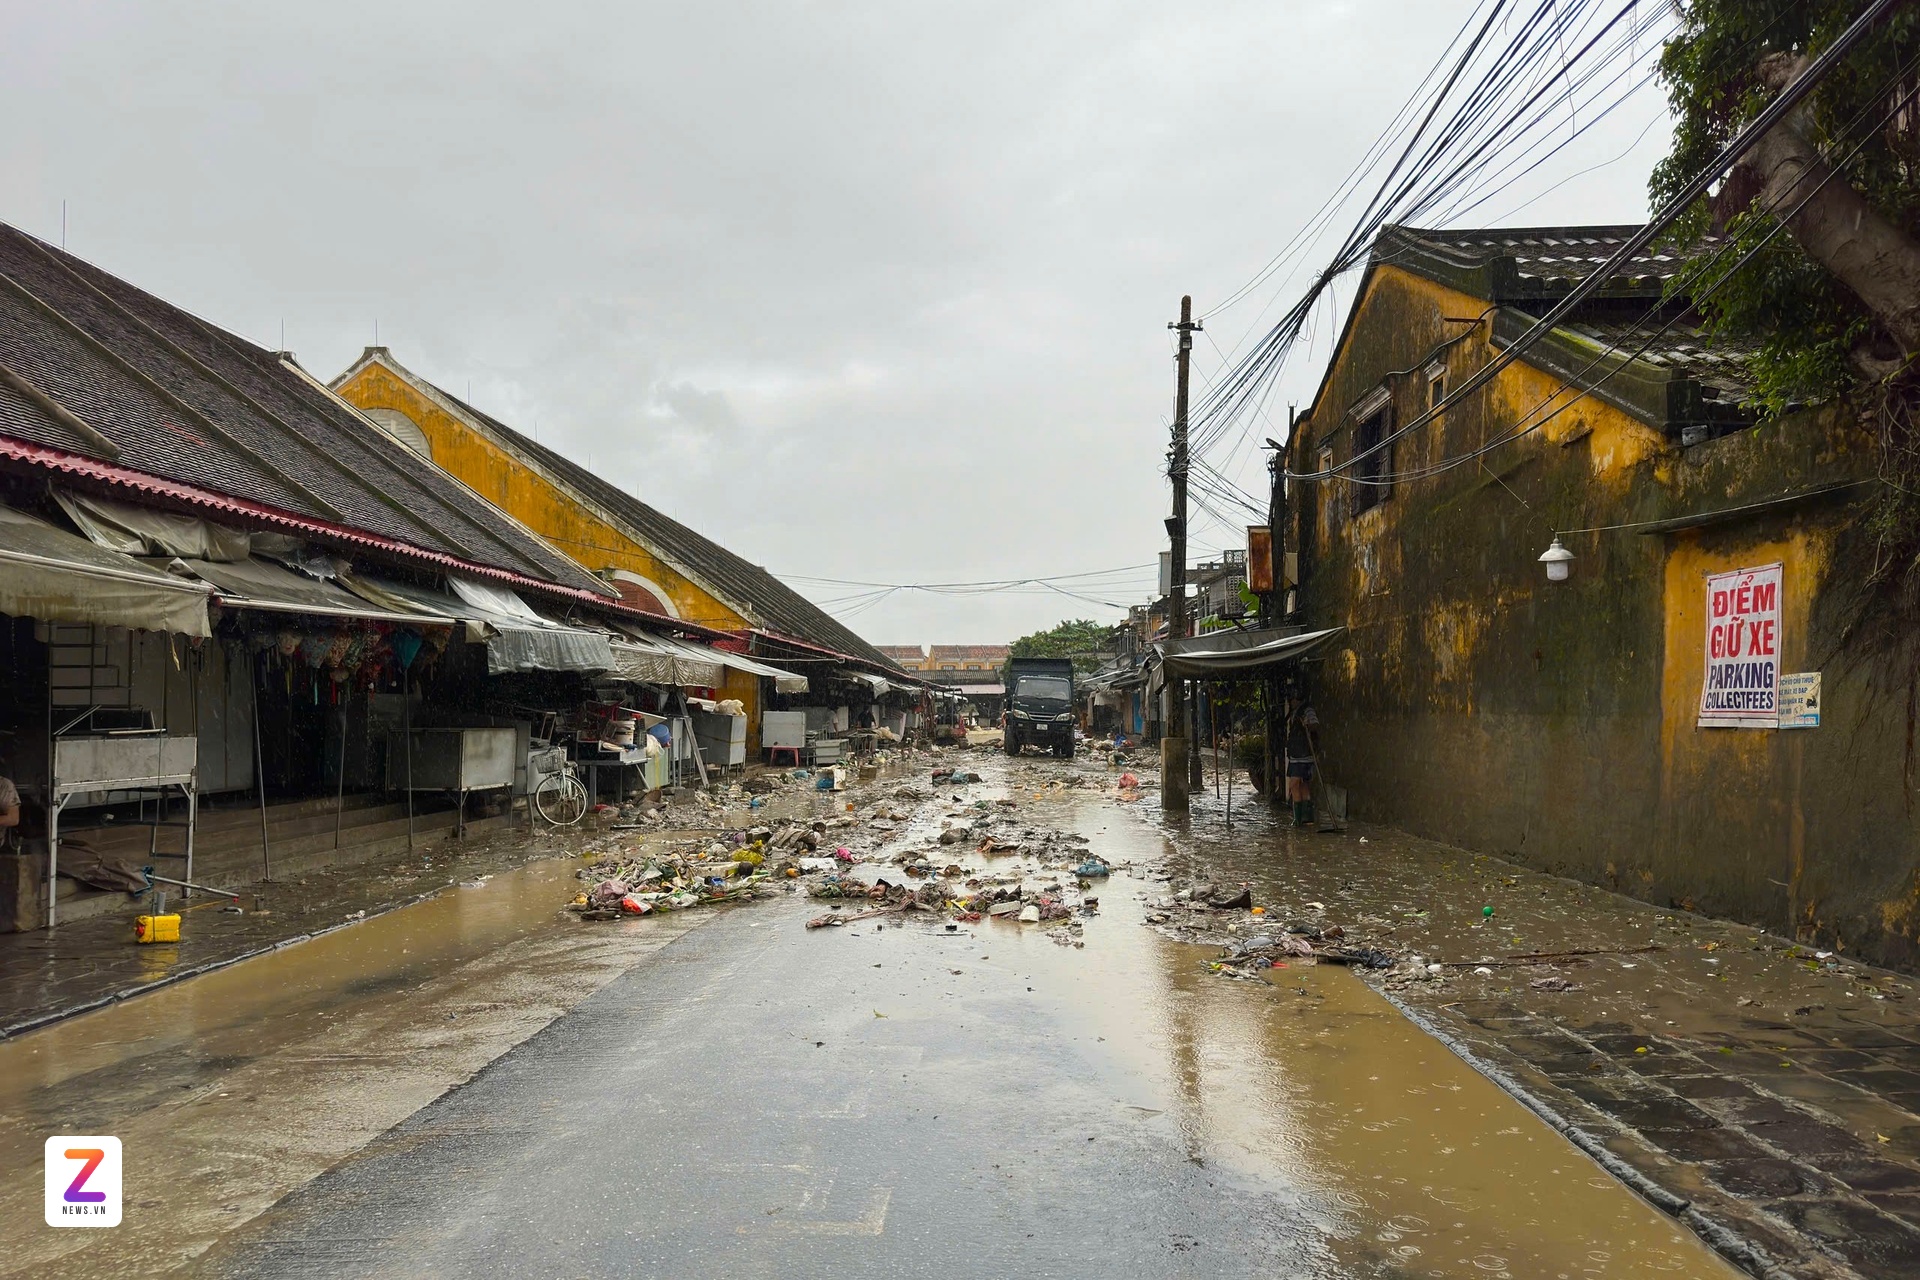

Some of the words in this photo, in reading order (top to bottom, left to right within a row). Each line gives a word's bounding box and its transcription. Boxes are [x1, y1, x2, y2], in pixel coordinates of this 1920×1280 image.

[1713, 575, 1776, 618] ĐIỂM
[1710, 616, 1745, 659] GIỮ
[1748, 620, 1775, 656] XE
[1709, 661, 1774, 690] PARKING
